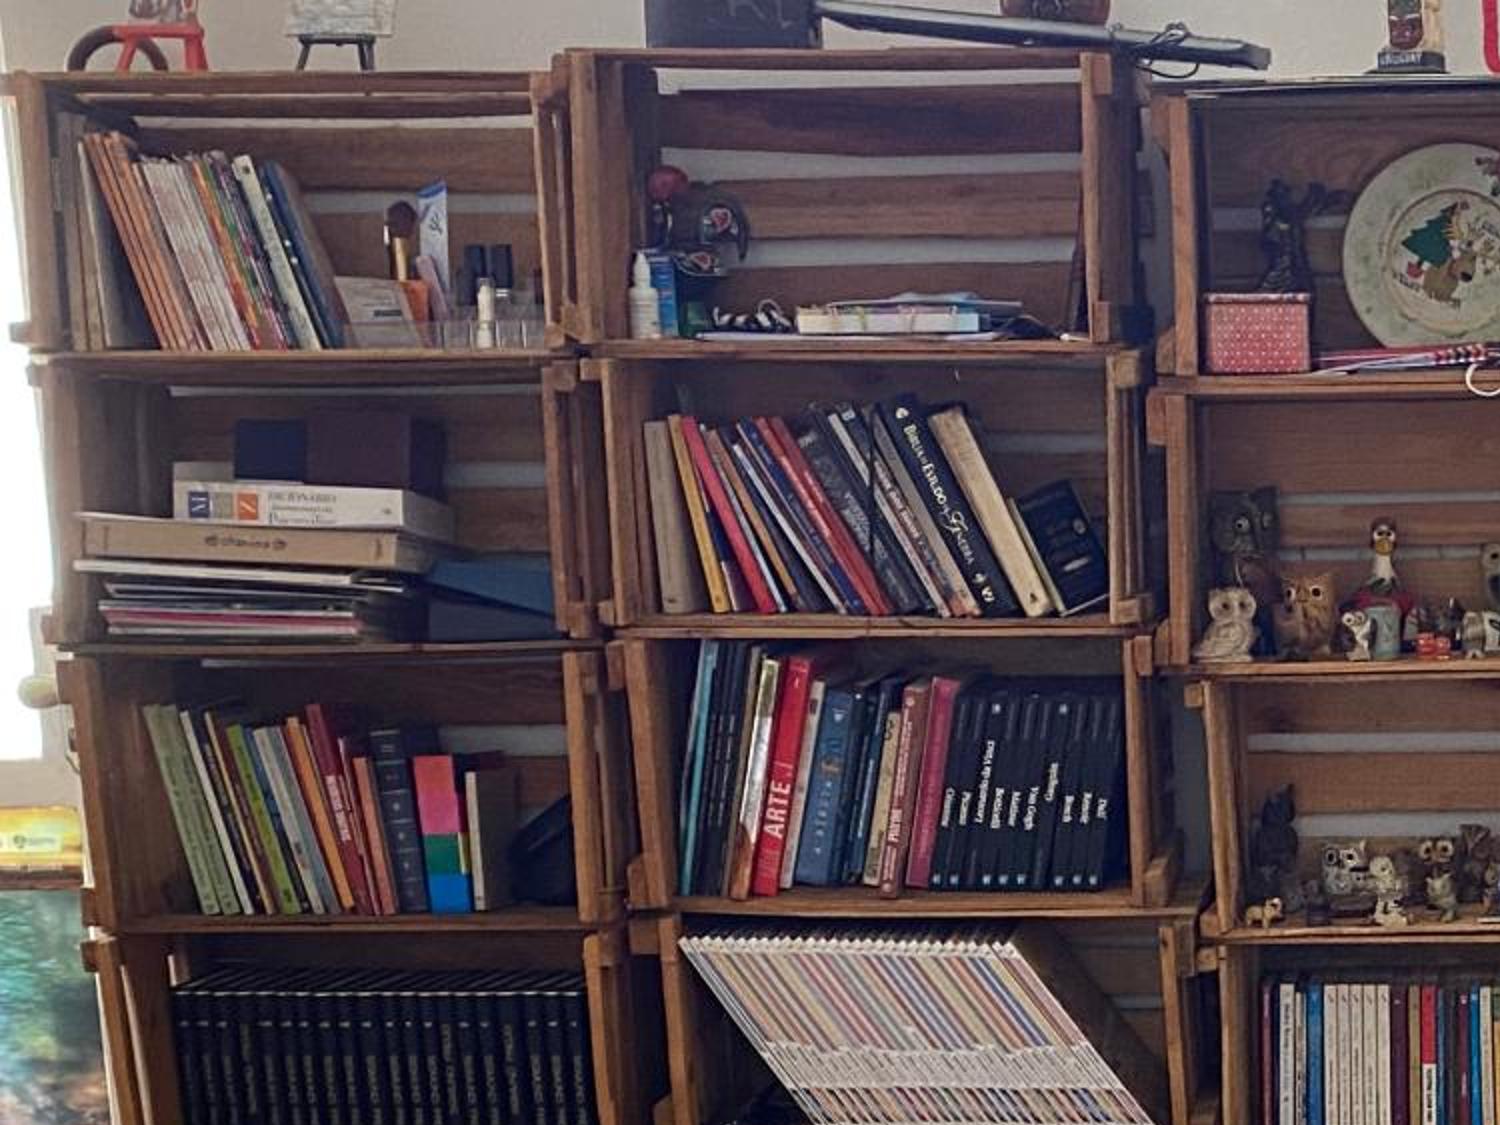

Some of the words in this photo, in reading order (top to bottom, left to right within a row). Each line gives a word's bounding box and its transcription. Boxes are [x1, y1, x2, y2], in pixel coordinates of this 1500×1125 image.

[980, 765, 992, 779] da
[974, 779, 990, 824] Leonardo
[1028, 785, 1040, 805] Van
[762, 780, 790, 840] ARTE
[1023, 804, 1037, 831] Gogh
